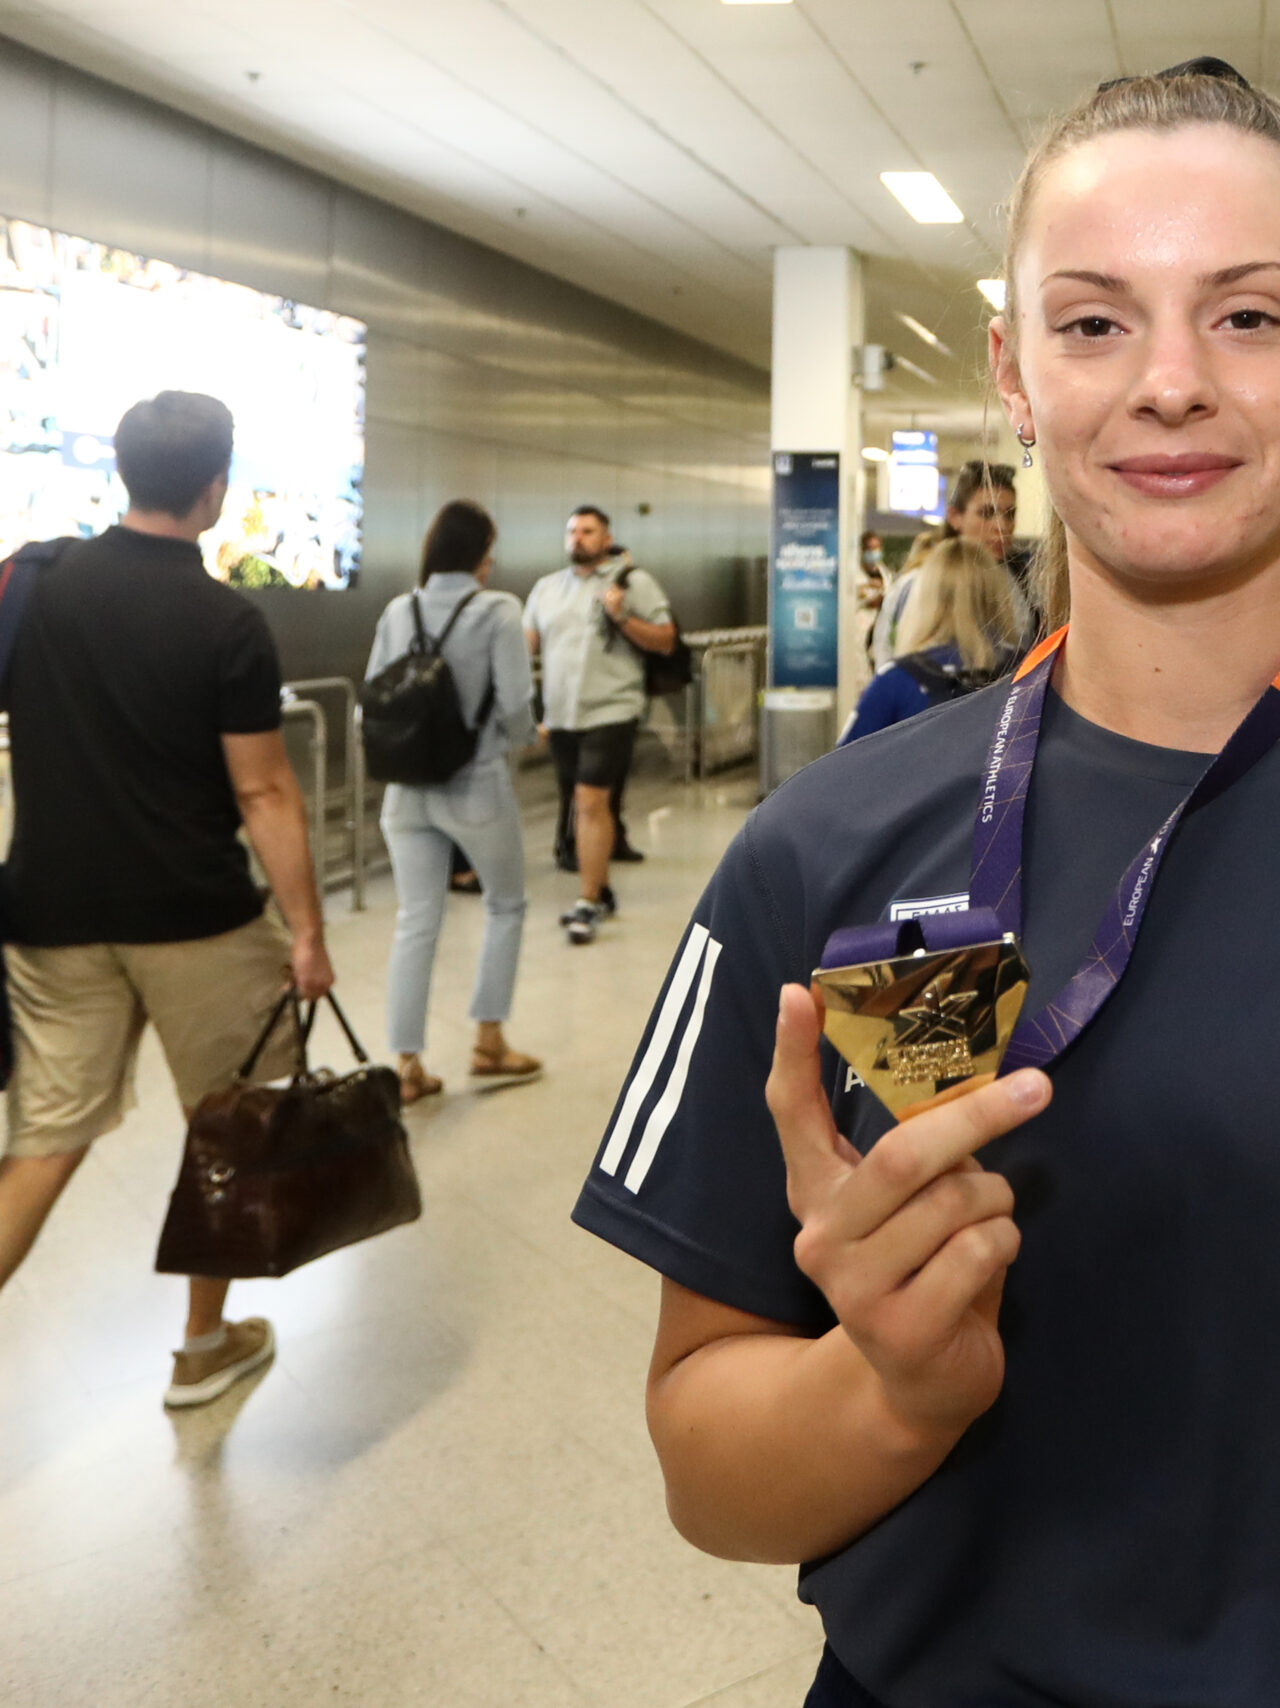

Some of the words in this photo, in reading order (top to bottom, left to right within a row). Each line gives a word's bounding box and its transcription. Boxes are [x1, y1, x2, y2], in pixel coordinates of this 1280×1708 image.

[993, 695, 1018, 754] EUROPEAN
[981, 755, 1002, 824] ATHLETICS
[1122, 856, 1155, 927] EUROPEAN
